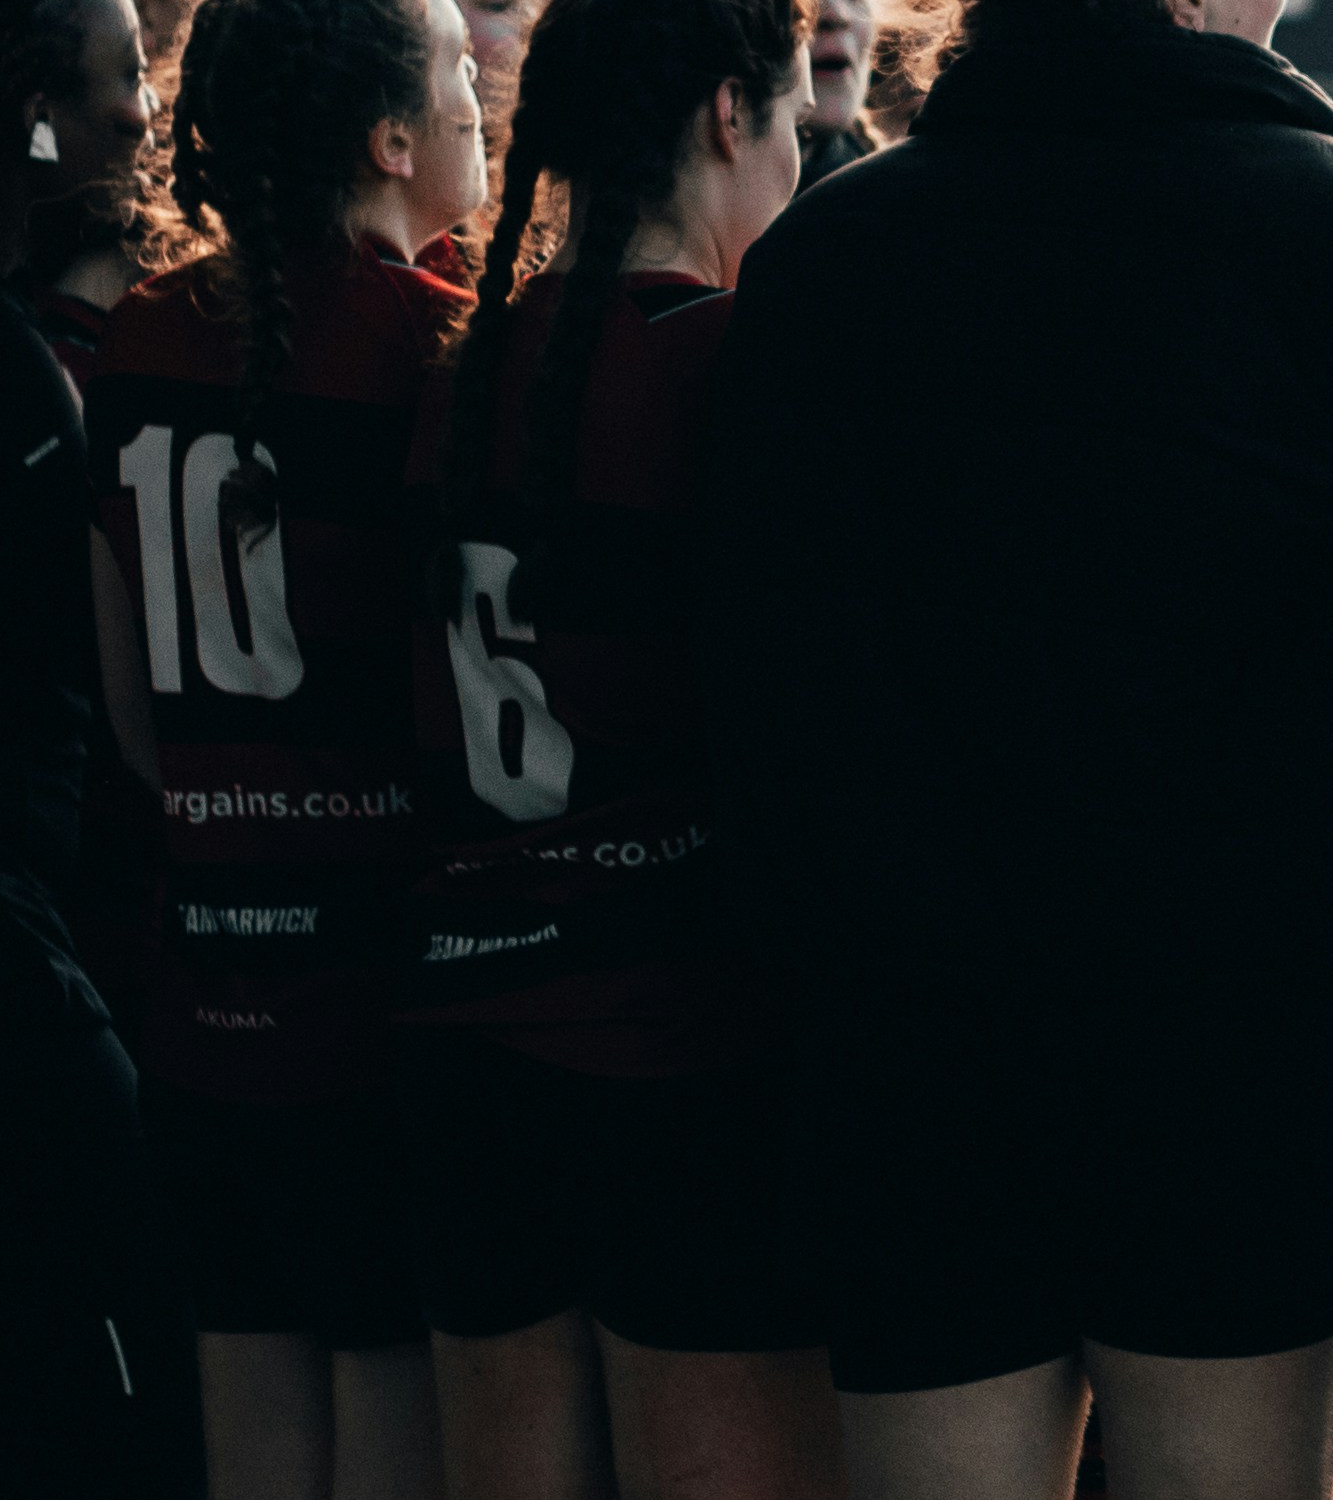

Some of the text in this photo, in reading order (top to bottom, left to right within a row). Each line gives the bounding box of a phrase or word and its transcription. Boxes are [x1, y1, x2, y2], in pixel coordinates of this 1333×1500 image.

[117, 423, 305, 700] 10
[447, 540, 575, 824] 6
[163, 782, 414, 825] argains.co.uk
